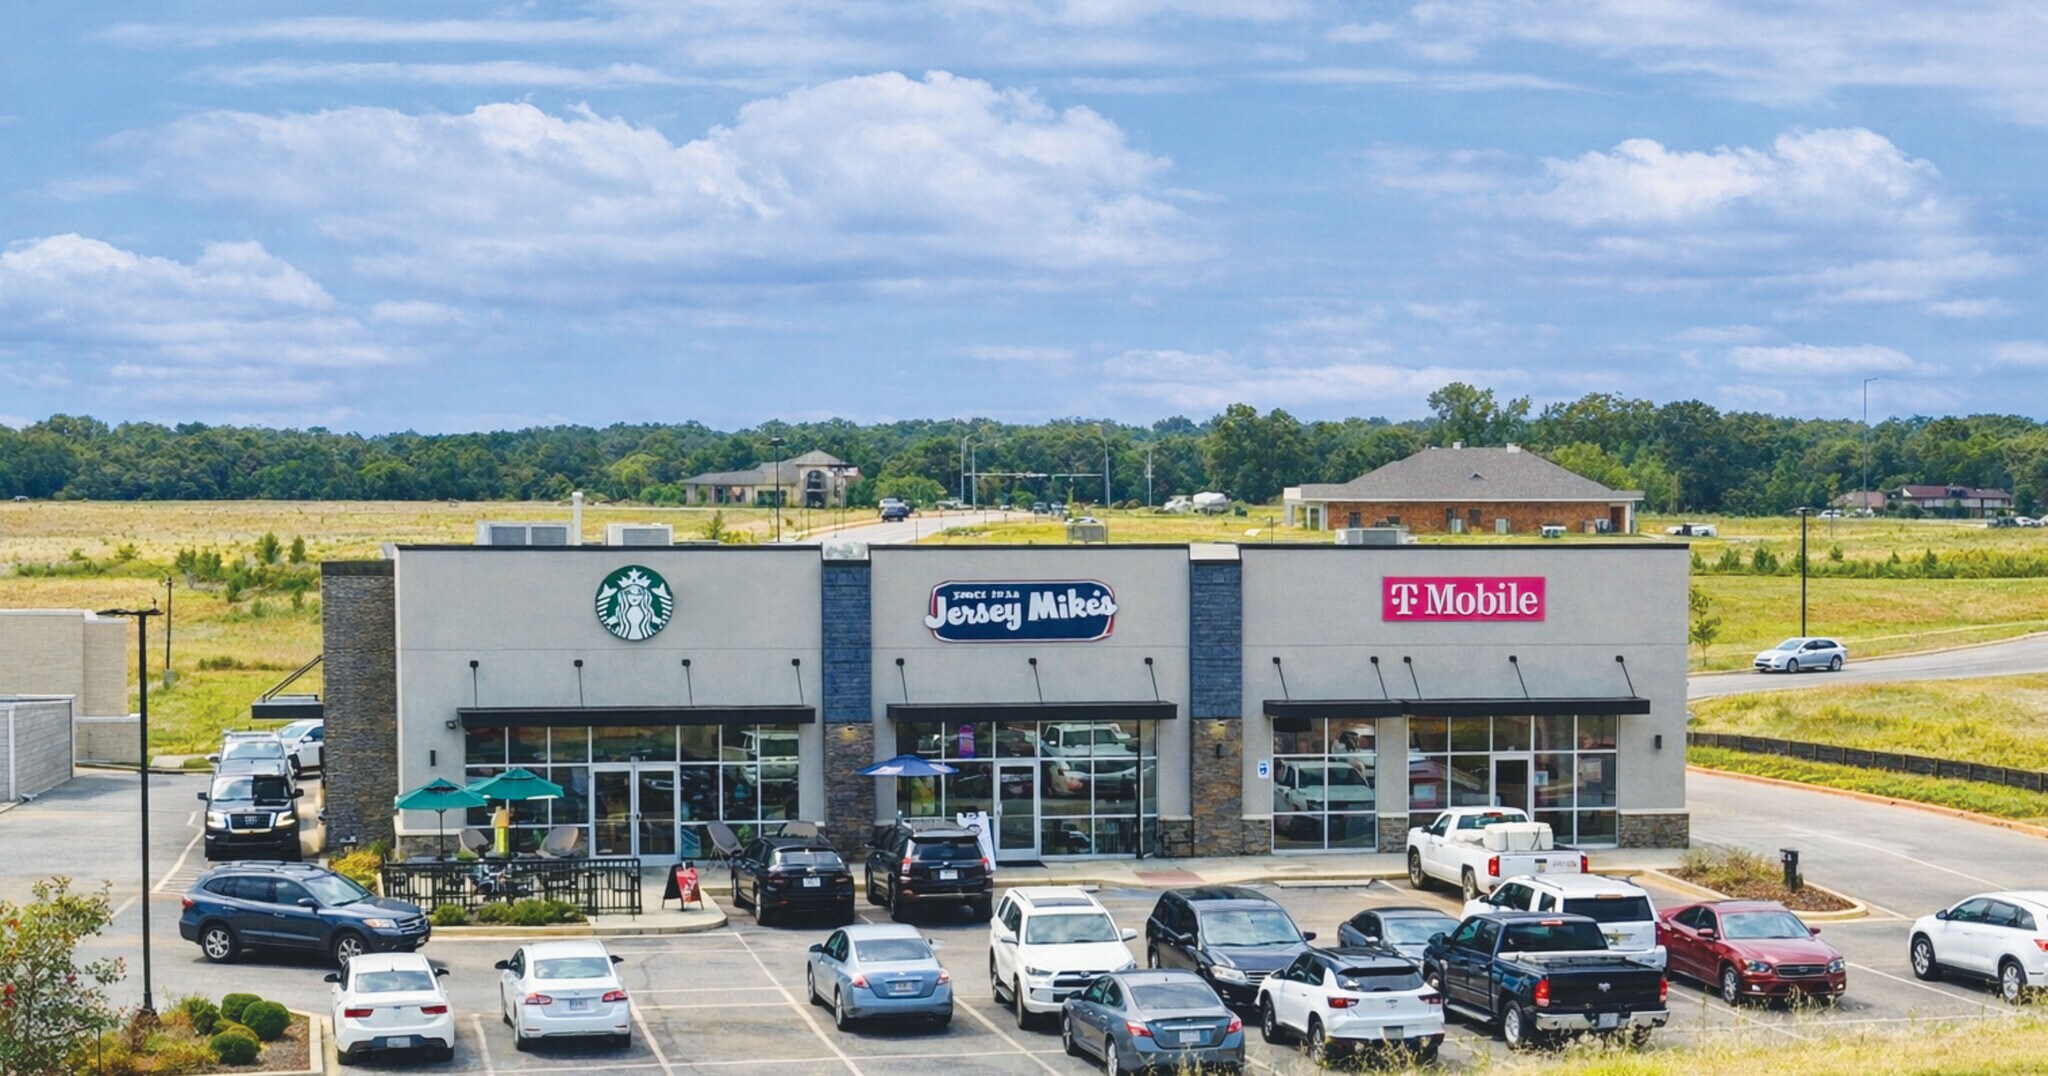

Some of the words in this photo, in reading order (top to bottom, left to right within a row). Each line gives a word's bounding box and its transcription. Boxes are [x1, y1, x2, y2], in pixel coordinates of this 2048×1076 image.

[925, 596, 1022, 631] Jersey
[1027, 588, 1119, 621] Mike's
[1391, 583, 1418, 615] T
[1424, 582, 1539, 616] Mobile
